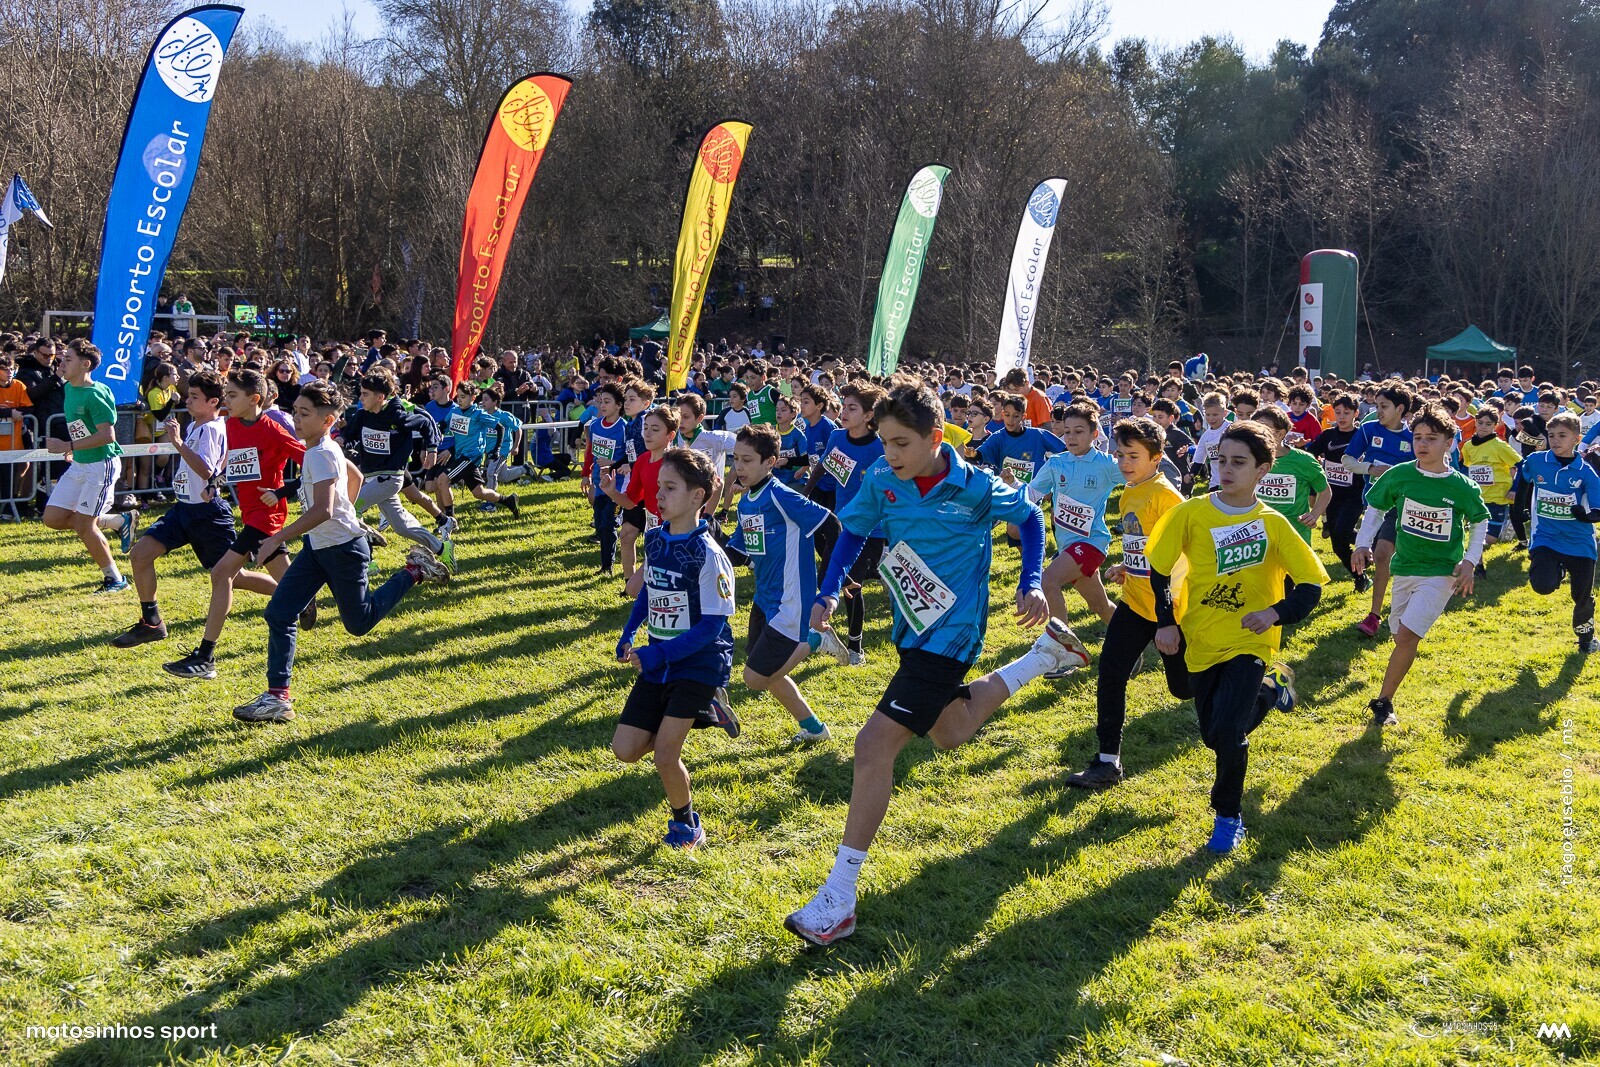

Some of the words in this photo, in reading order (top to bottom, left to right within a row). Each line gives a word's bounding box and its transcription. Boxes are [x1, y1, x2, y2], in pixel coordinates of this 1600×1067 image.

[479, 164, 521, 258] Escolar
[105, 245, 155, 381] Desporto
[137, 121, 190, 237] Escolar
[896, 227, 926, 295] Escolar
[1021, 238, 1043, 301] Escolar
[670, 281, 701, 373] Desporto
[692, 196, 718, 275] Escolar
[1015, 305, 1031, 368] esporto
[451, 422, 466, 431] 2074
[364, 439, 385, 450] 3669
[593, 444, 610, 456] 2336
[229, 464, 254, 475] 3407
[825, 455, 846, 478] 2358
[1012, 470, 1029, 479] 357
[1327, 471, 1348, 481] 3440
[1471, 474, 1490, 482] 2037
[1258, 485, 1289, 497] 4639
[1540, 502, 1571, 515] 2368
[1058, 510, 1086, 528] 2147
[1407, 516, 1443, 534] 3441
[743, 533, 759, 546] 338
[1124, 553, 1147, 568] 2041
[1224, 543, 1261, 564] 2303
[895, 552, 936, 592] CORTA-MATO
[891, 565, 931, 613] 4627
[650, 612, 680, 628] 717
